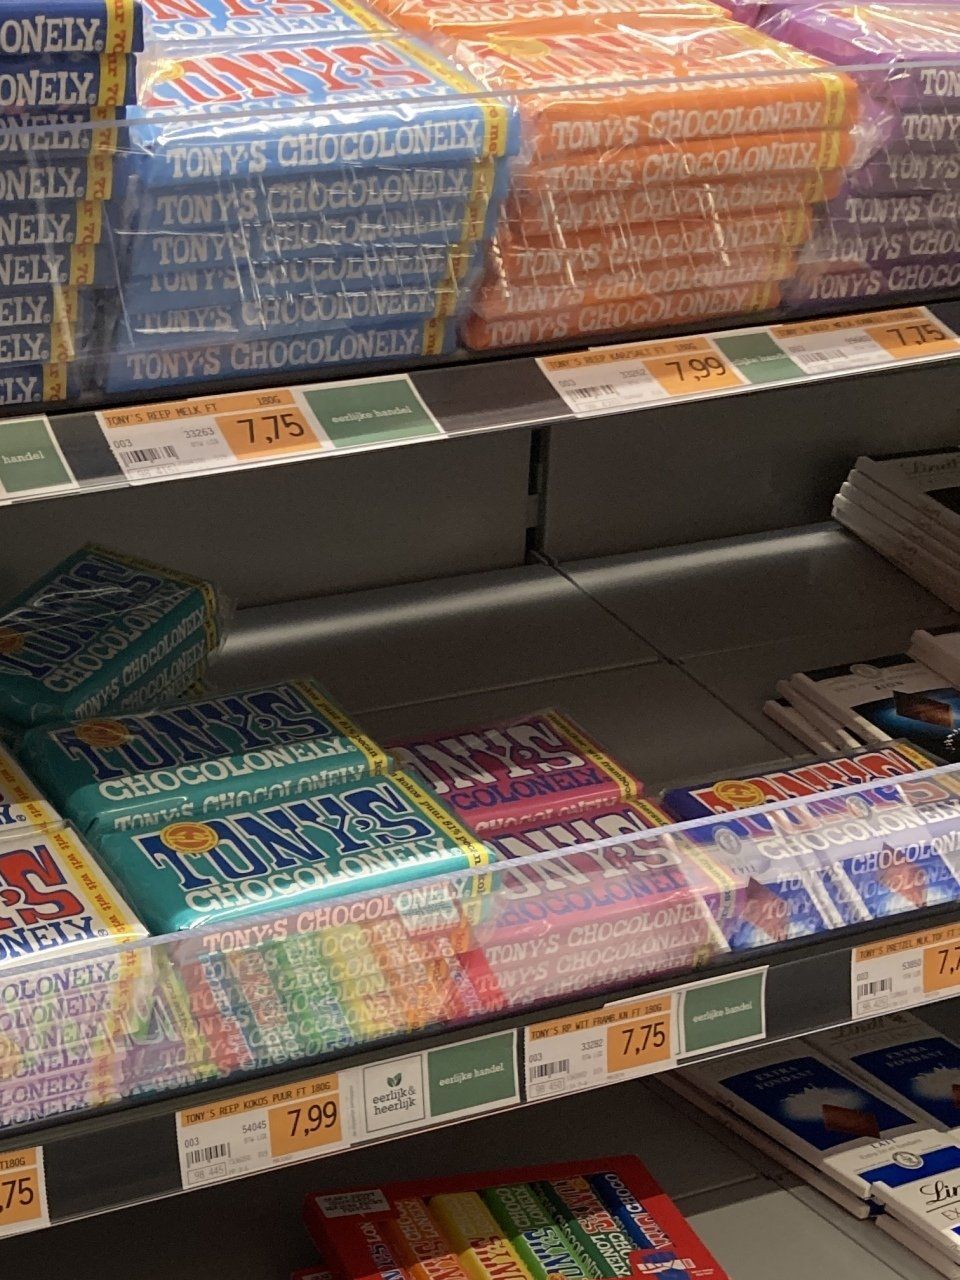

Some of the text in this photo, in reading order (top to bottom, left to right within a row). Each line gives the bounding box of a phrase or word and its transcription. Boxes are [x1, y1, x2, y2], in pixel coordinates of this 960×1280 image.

[552, 101, 821, 148] TONY'S CHOCOLONELY
[167, 119, 480, 179] TONY'S CHOCOLONELY
[887, 321, 947, 346] 7,75
[665, 356, 727, 382] 7,99
[106, 395, 281, 426] TONY'S MELK 180G
[184, 427, 215, 440] 33263
[237, 416, 305, 444] 7,75
[1, 450, 45, 464] handel
[53, 688, 333, 782] TONY'S
[97, 739, 353, 802] CHOCOLONELY
[136, 784, 433, 892] TONY'S
[185, 837, 459, 912] CHOCOLONELY
[203, 879, 469, 955] TONY'S CHOCOLONELY
[622, 1022, 665, 1055] 7,75
[185, 1091, 293, 1124] TONY'S KOKOS PUUR
[287, 1101, 338, 1138] 7,99
[242, 1120, 267, 1135] 54045
